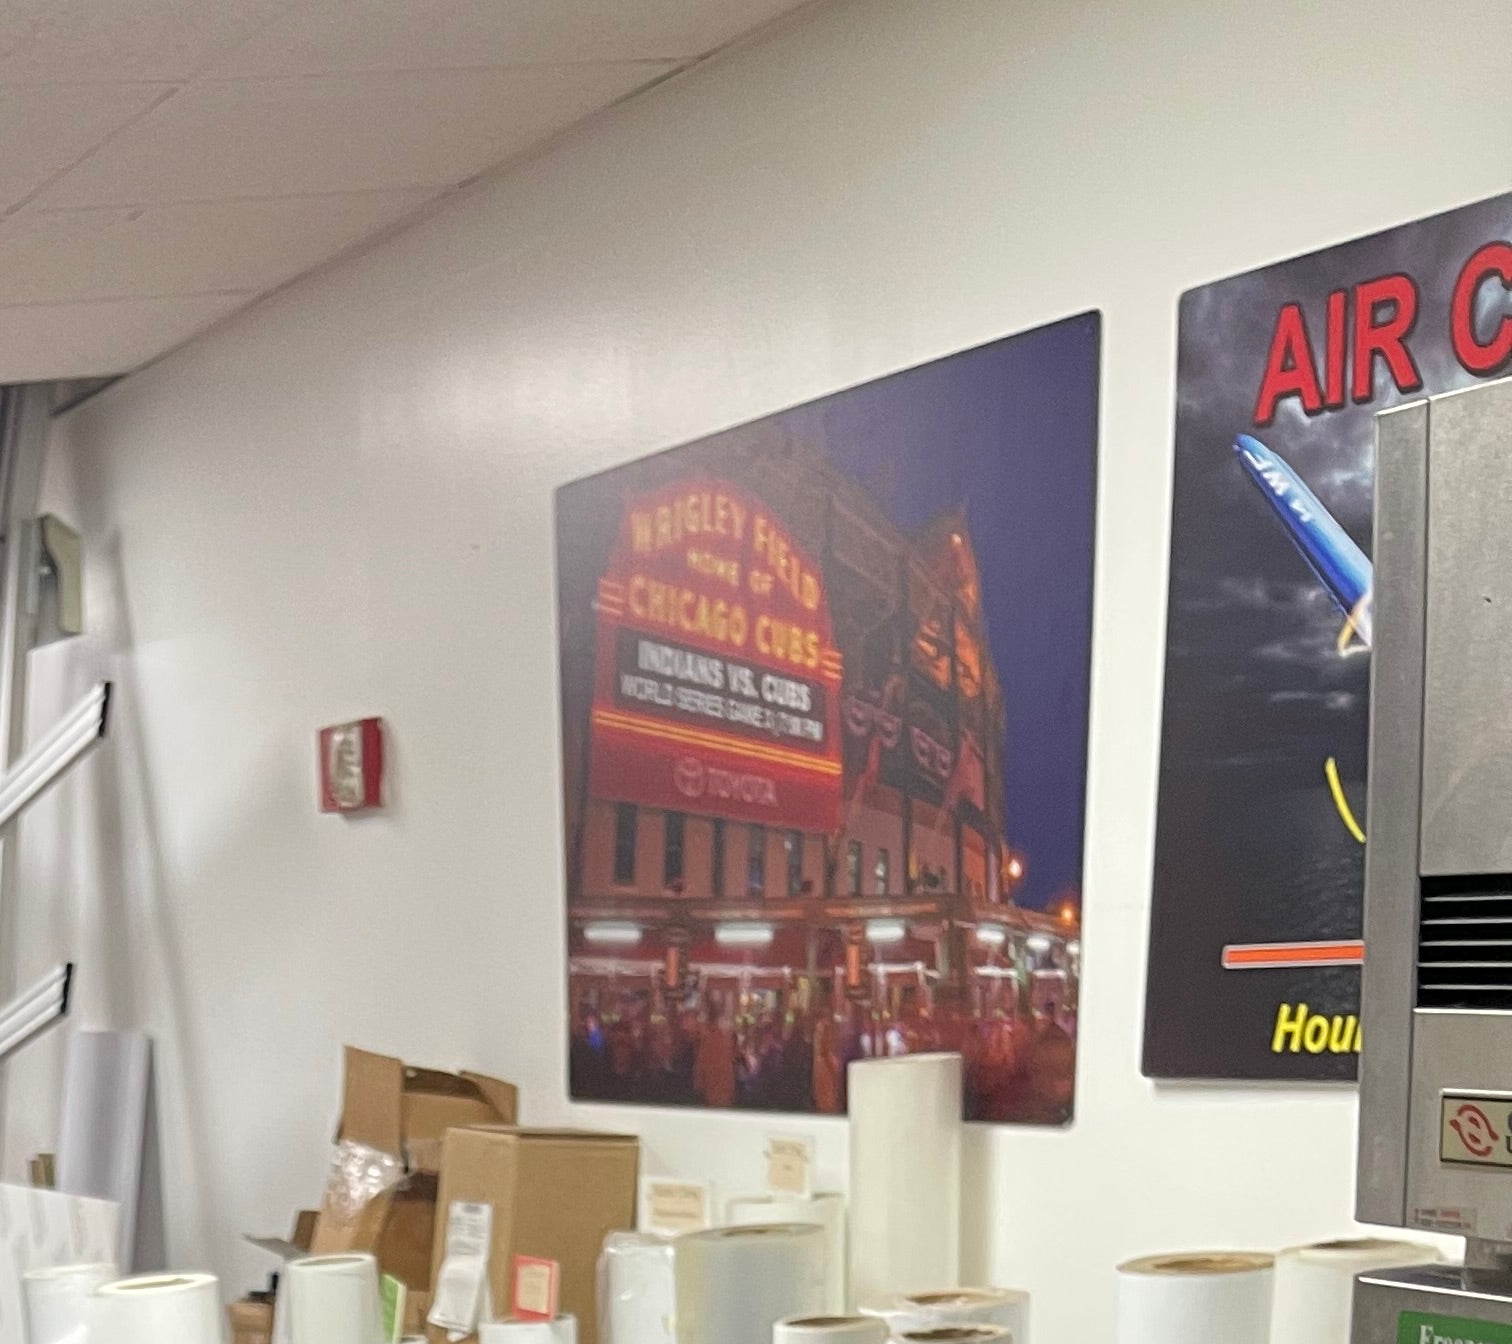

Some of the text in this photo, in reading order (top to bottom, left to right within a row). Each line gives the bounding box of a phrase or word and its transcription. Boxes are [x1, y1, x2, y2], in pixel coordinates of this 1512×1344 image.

[1254, 269, 1420, 425] AIR
[631, 494, 820, 611] WRIGLEY FIELD
[748, 570, 773, 597] OF
[629, 575, 819, 669] CHICAGO CUBS
[638, 639, 724, 688] INDIANS
[761, 674, 812, 712] CUBS
[707, 766, 779, 807] TOYOTA
